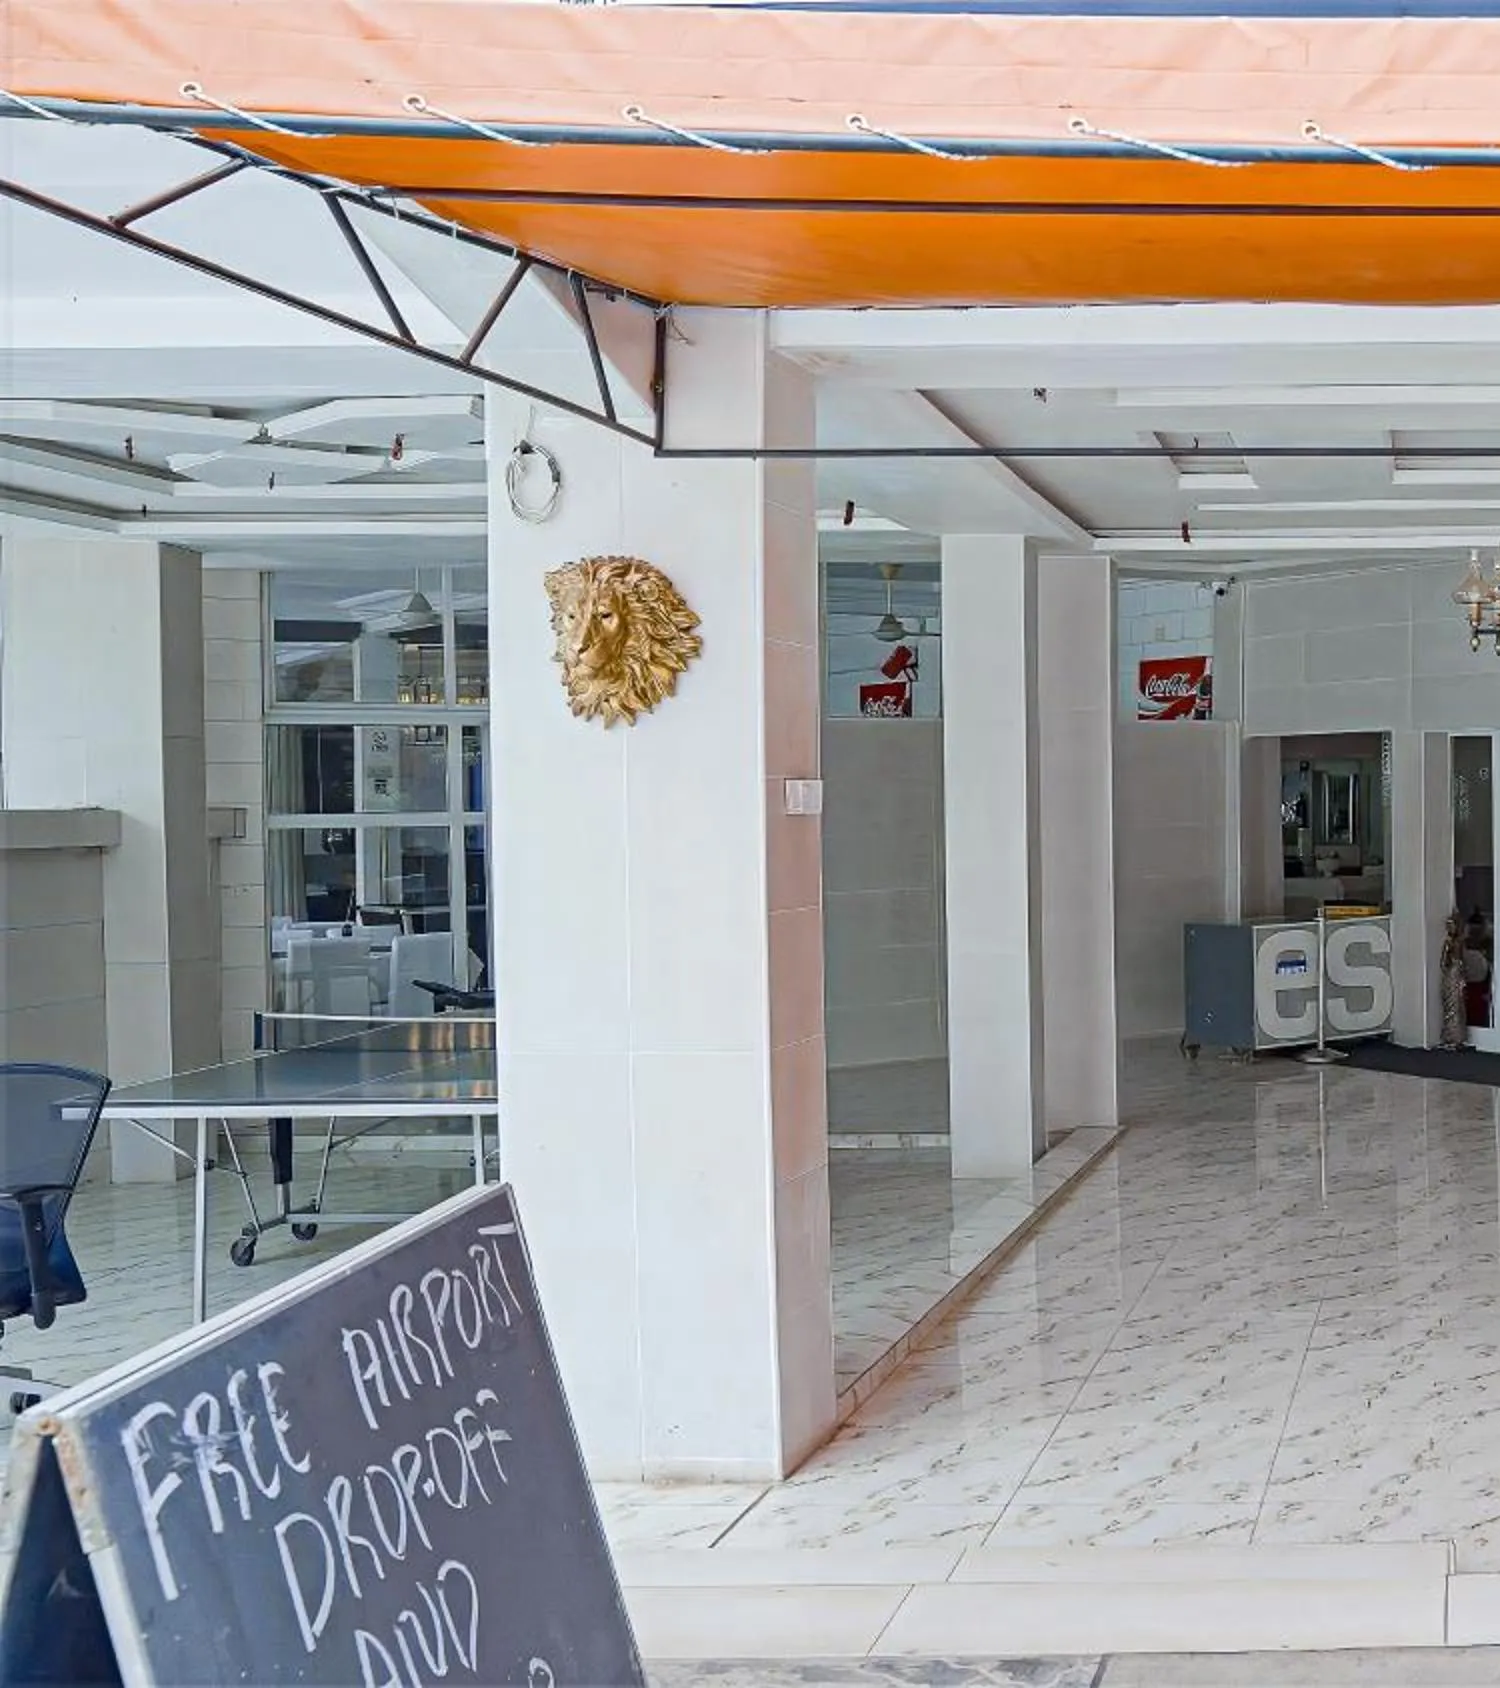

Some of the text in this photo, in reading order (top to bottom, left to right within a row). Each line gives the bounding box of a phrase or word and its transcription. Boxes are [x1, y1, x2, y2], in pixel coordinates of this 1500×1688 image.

[120, 1221, 523, 1601] FREE AIRPORT
[354, 1560, 479, 1688] AND
